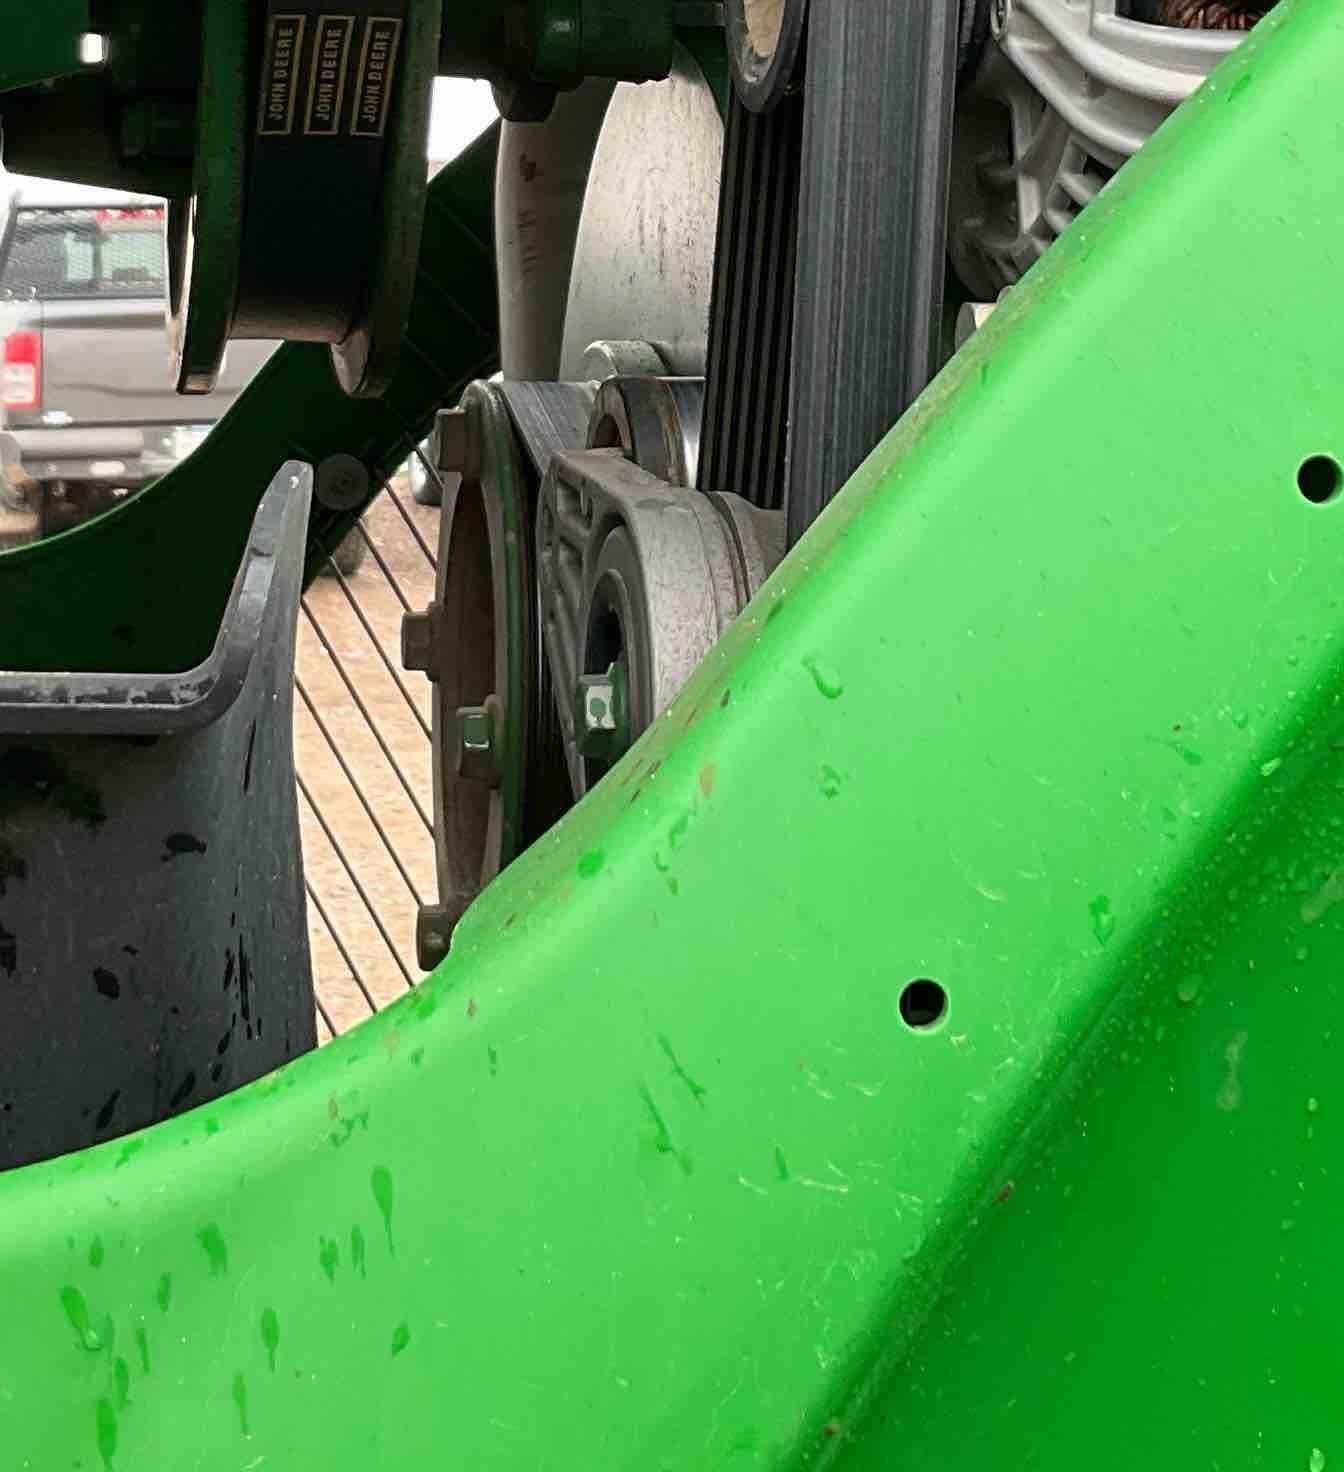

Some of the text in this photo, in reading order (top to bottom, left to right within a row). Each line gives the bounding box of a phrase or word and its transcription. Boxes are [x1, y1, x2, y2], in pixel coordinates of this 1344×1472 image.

[269, 27, 293, 120] JOHN DEERE
[315, 29, 342, 120] JOHN DEERE
[362, 31, 392, 122] JOHN DEERE
